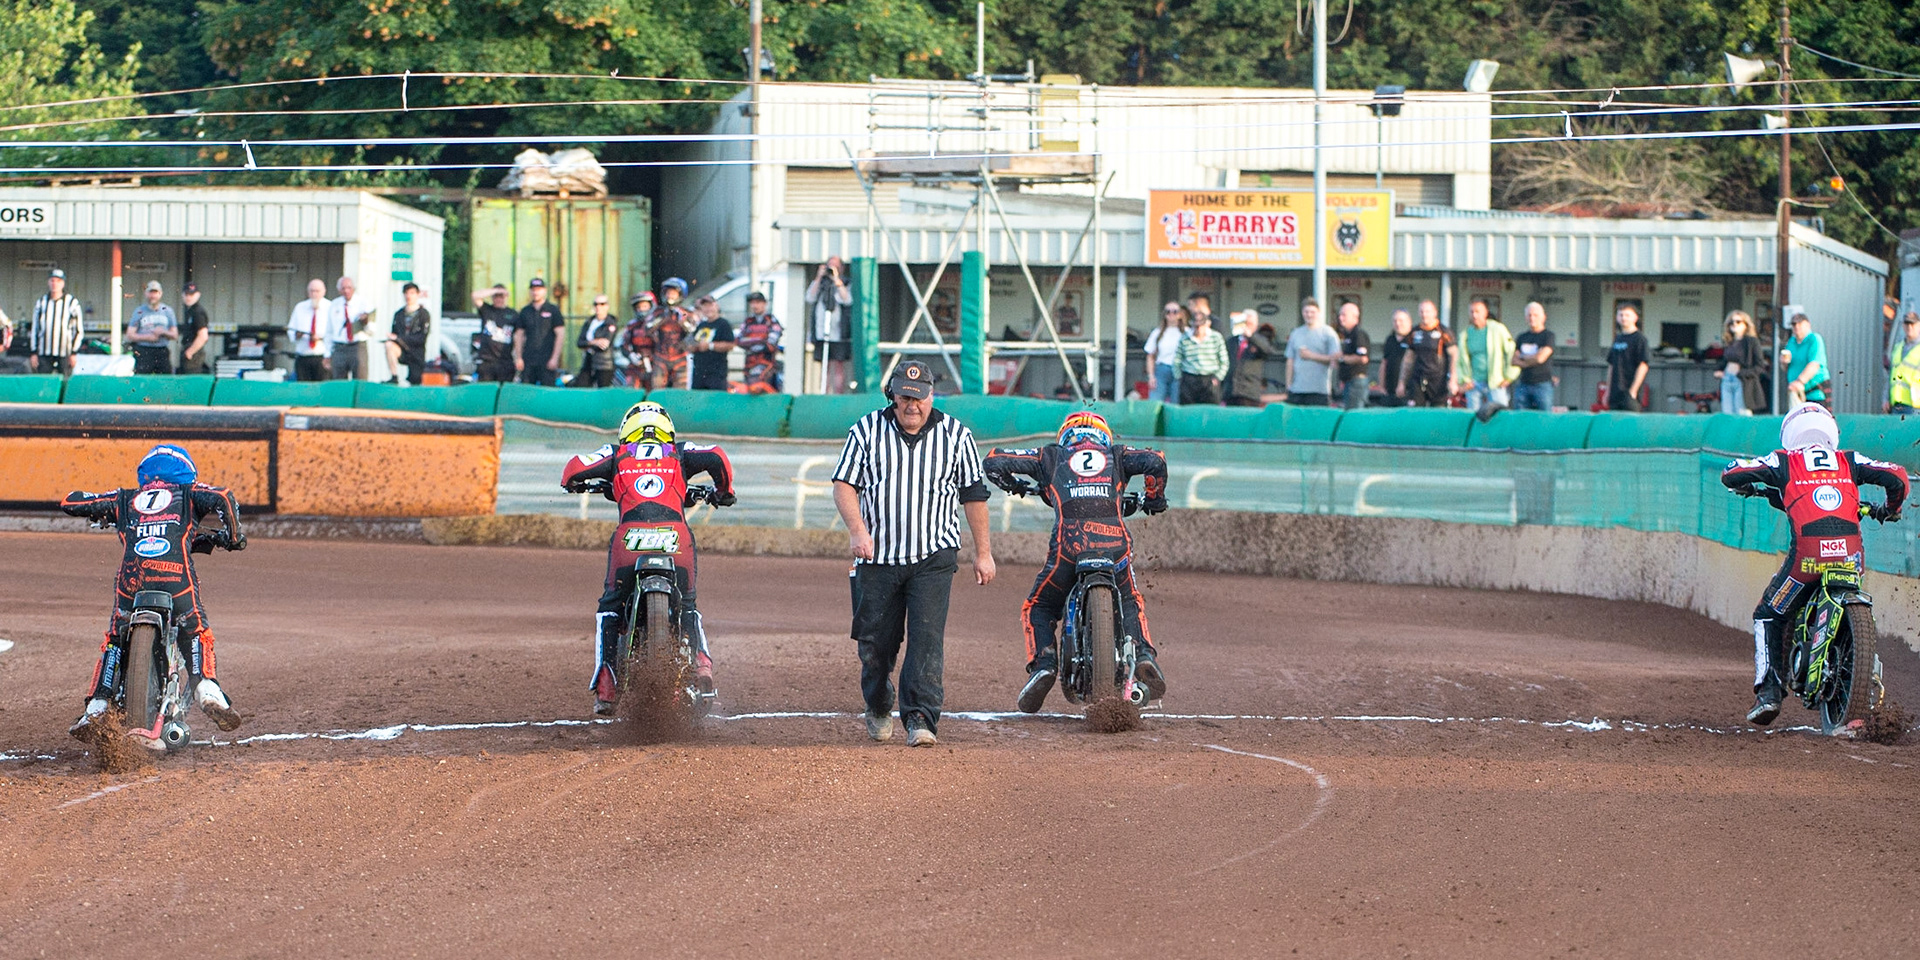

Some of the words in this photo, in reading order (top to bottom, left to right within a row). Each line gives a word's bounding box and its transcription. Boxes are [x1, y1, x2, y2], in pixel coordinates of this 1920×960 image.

[1183, 194, 1231, 208] HOME
[1234, 194, 1255, 208] OF
[1261, 194, 1291, 208] THE
[0, 207, 44, 223] ORS
[1202, 215, 1296, 233] PARRYS
[1200, 235, 1297, 246] INTERNATIONAL
[1157, 249, 1256, 261] WOLVERHAMPTON
[1257, 250, 1303, 261] WOLVES
[642, 445, 655, 458] 7
[1812, 450, 1831, 467] 2
[1082, 452, 1093, 470] 2
[1069, 486, 1110, 498] WORRALL
[1818, 493, 1837, 501] ATPI
[146, 490, 160, 510] 7
[136, 524, 168, 538] FLINT
[1084, 522, 1123, 537] #WOLFPACK
[624, 531, 679, 551] TBR
[1821, 541, 1847, 551] NGK
